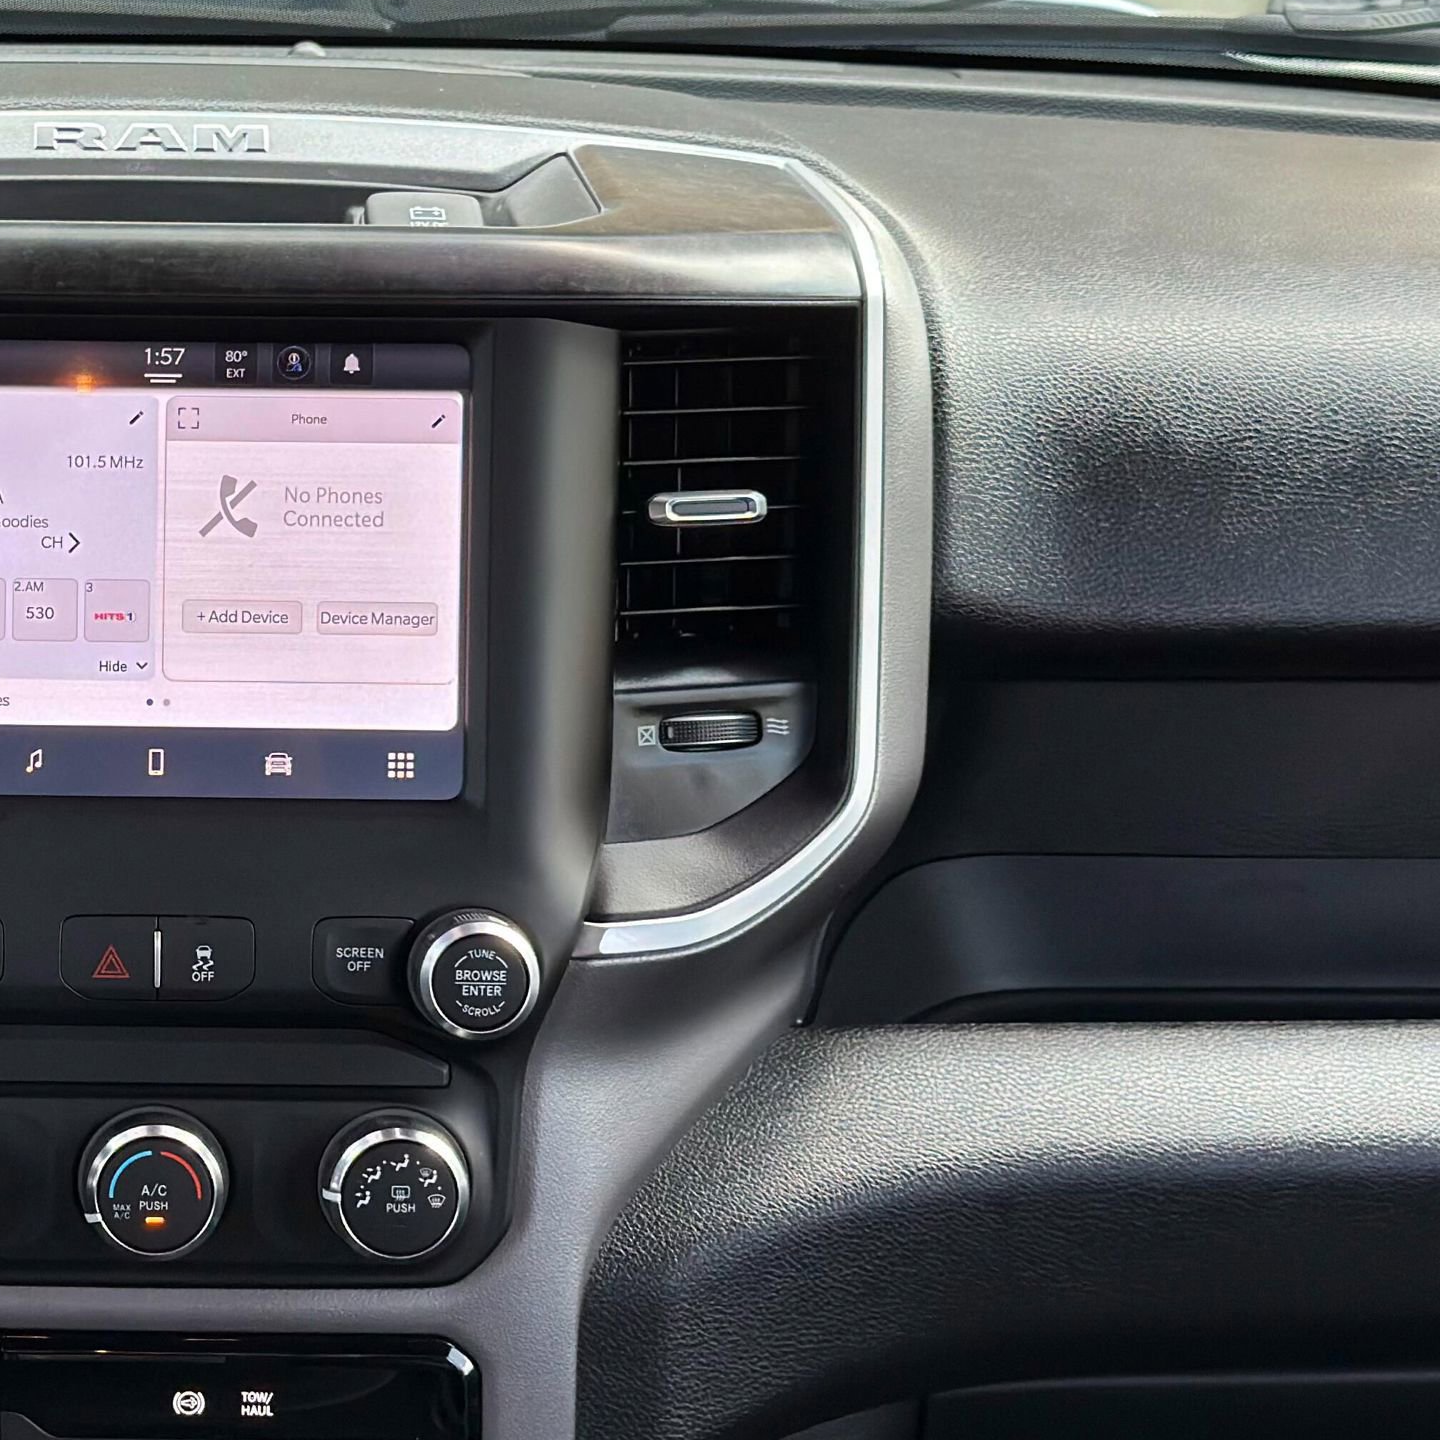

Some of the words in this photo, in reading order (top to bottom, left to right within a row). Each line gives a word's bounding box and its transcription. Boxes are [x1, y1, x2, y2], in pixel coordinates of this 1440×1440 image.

[34, 121, 269, 153] RAM
[144, 348, 185, 366] 1:57
[225, 350, 248, 363] 80°
[226, 369, 245, 379] EXT
[291, 414, 328, 425] Phone
[67, 455, 107, 469] 101.5
[110, 455, 144, 469] MHz
[284, 488, 311, 504] No
[316, 488, 383, 504] Phones
[283, 510, 384, 528] Connected
[41, 536, 63, 550] CH
[13, 581, 44, 593] 2.AM
[85, 582, 94, 594] 3
[25, 606, 55, 620] 530
[94, 612, 125, 621] HITS
[208, 610, 238, 624] Add
[241, 610, 289, 624] Device
[320, 611, 368, 625] Device
[371, 612, 436, 629] Manager
[98, 660, 128, 673] Hide
[335, 947, 384, 959] SCREEN
[468, 948, 496, 961] TUNE
[347, 961, 371, 972] OFF
[191, 971, 215, 982] OFF
[455, 970, 507, 982] BROWSE
[461, 985, 502, 997] ENTER
[462, 1004, 501, 1017] SCROLL
[140, 1183, 167, 1197] A/C
[112, 1203, 132, 1212] MAX
[139, 1200, 169, 1211] PUSH
[386, 1203, 416, 1213] PUSH
[113, 1211, 131, 1220] A/C
[241, 1391, 273, 1405] TOW/
[241, 1405, 274, 1417] HAUL
